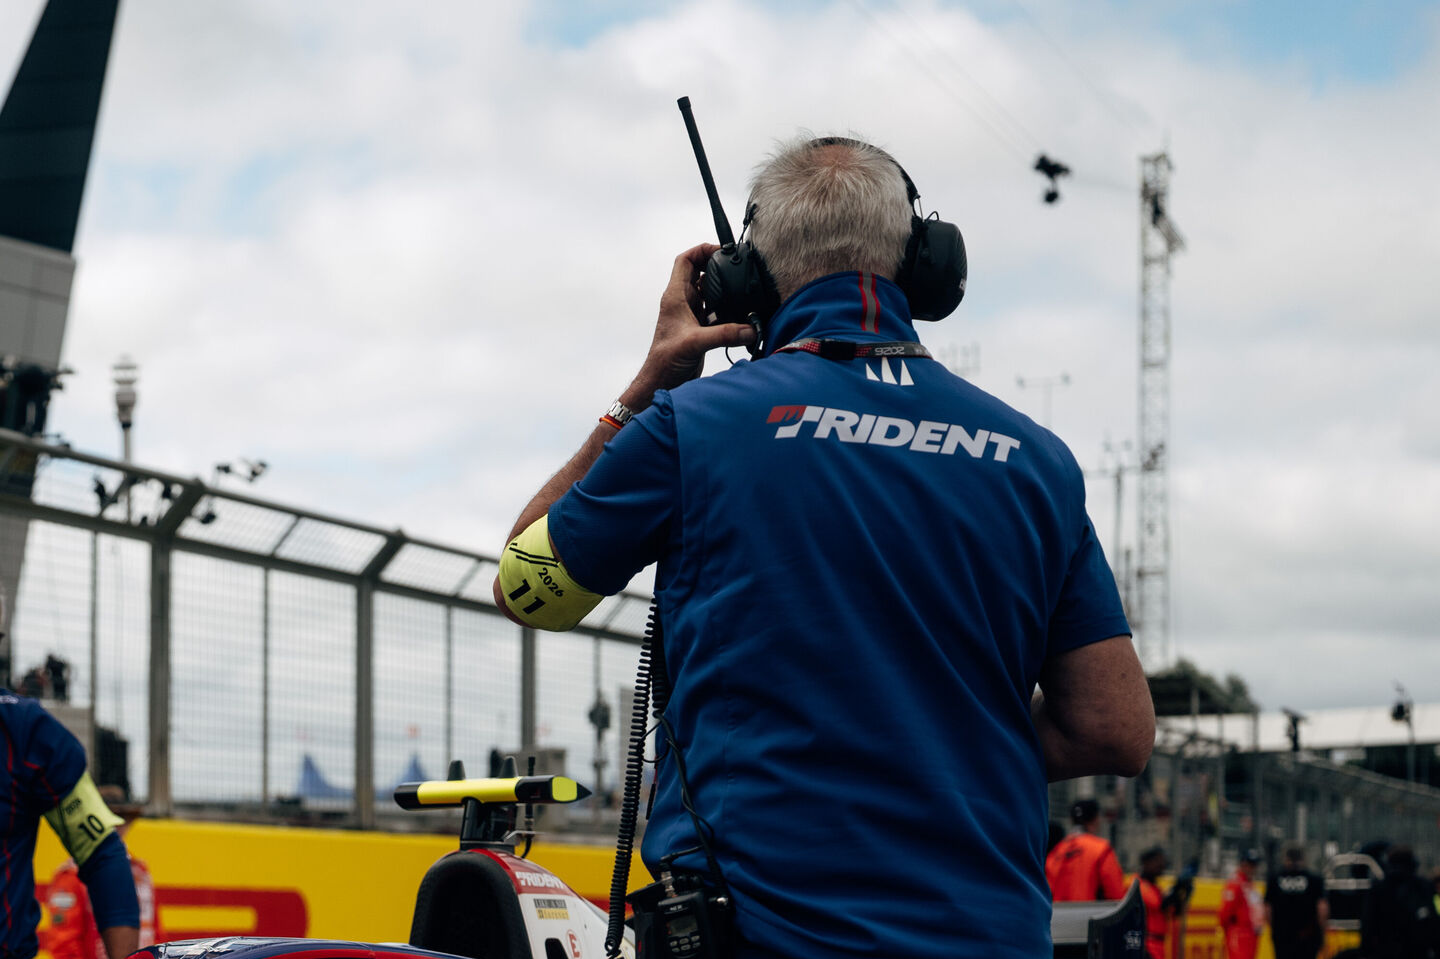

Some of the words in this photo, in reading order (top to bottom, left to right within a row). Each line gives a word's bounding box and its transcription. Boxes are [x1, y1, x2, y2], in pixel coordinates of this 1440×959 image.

[766, 405, 1021, 463] TRIDENT
[508, 578, 546, 615] 11
[537, 567, 565, 597] 2026
[77, 814, 105, 842] 10
